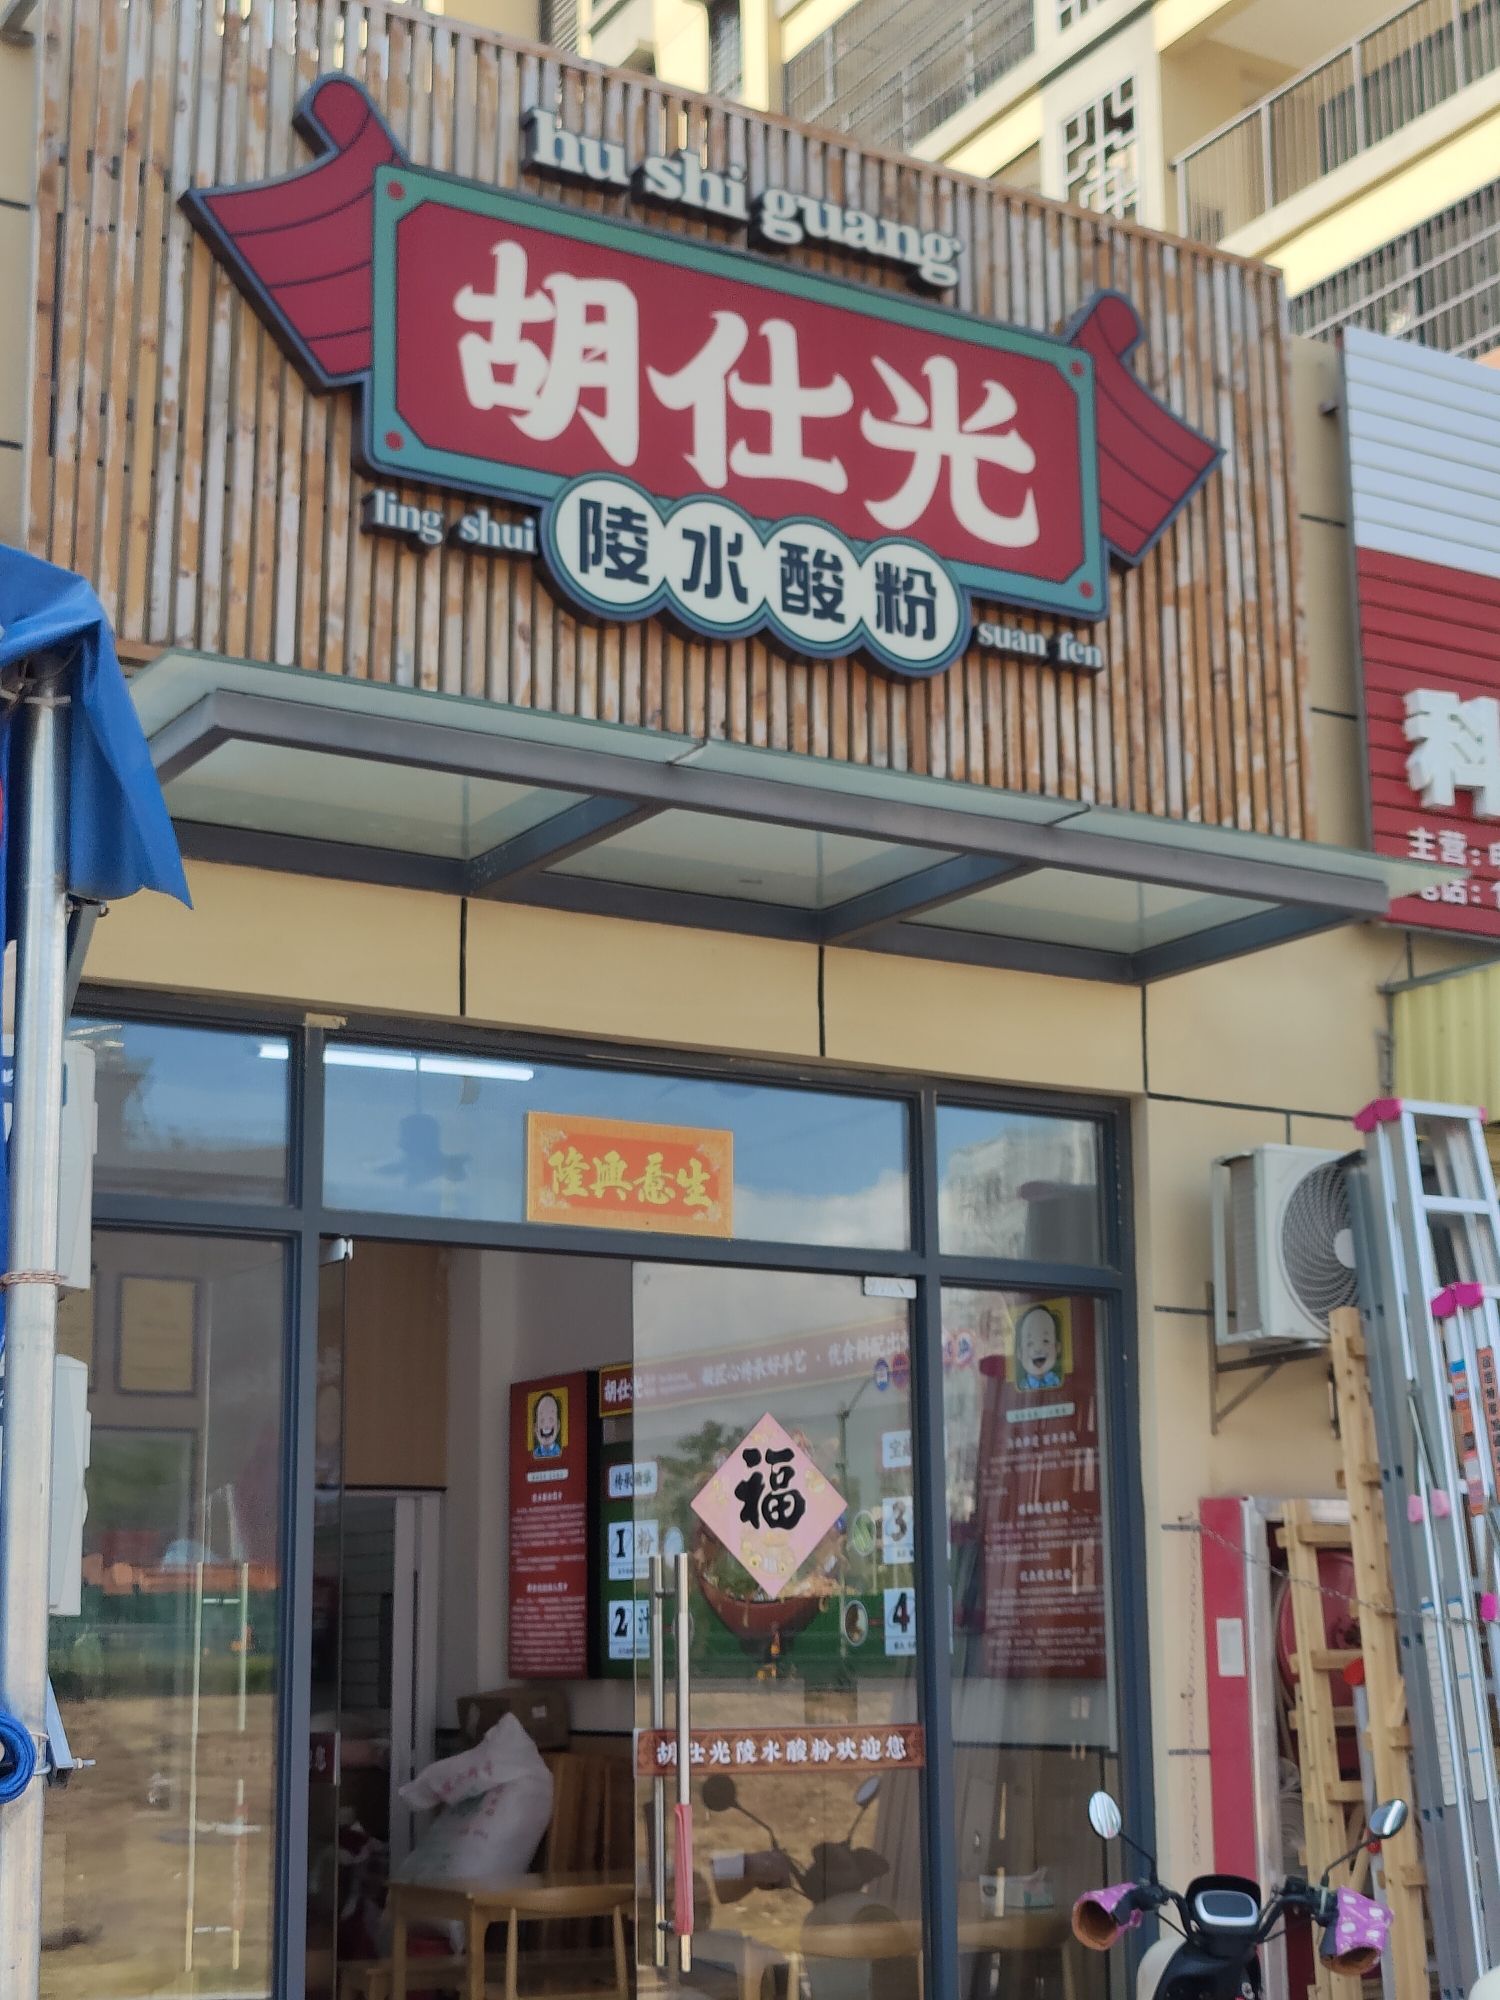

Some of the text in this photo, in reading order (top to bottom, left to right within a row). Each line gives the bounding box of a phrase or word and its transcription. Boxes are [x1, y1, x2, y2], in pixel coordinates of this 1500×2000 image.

[534, 107, 962, 288] hu shi guang
[453, 240, 1040, 548] 胡仕光
[372, 489, 538, 556] ling shui
[578, 498, 938, 642] 陵水酸粉
[976, 624, 1102, 668] suan fen
[733, 1447, 807, 1531] 福
[889, 1499, 908, 1542] 3
[614, 1605, 628, 1638] 2
[892, 1591, 911, 1634] 4
